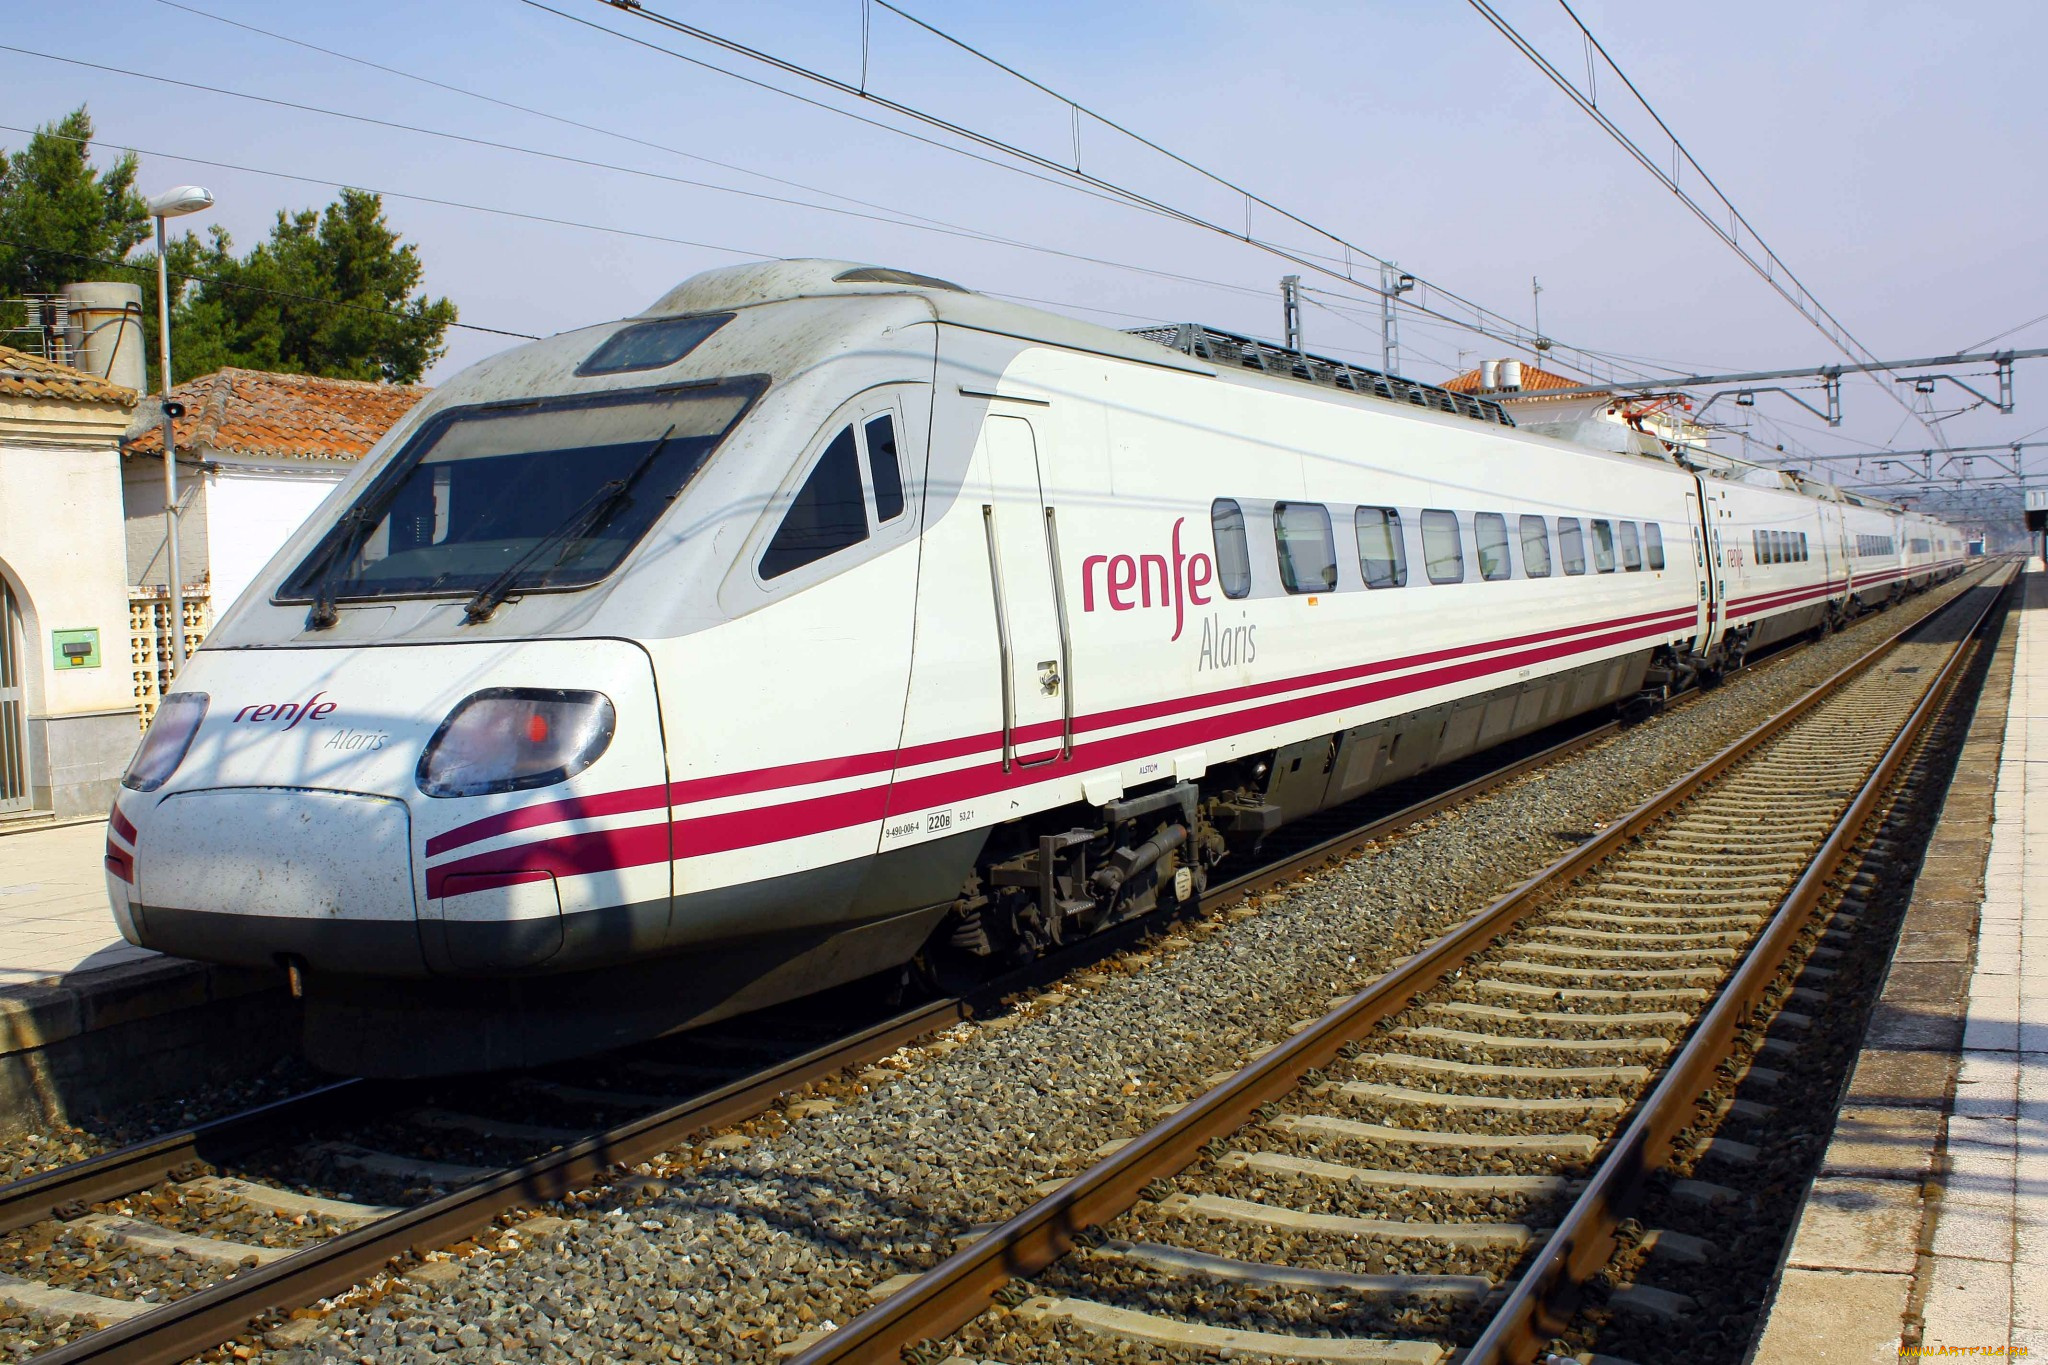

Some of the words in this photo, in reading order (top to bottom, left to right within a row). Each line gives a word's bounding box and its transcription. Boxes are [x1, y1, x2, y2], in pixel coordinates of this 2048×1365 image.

[1082, 517, 1212, 642] renfe
[1198, 610, 1257, 672] Alaris
[232, 690, 338, 732] renfe
[324, 728, 389, 751] Alaris
[928, 814, 951, 830] 220B
